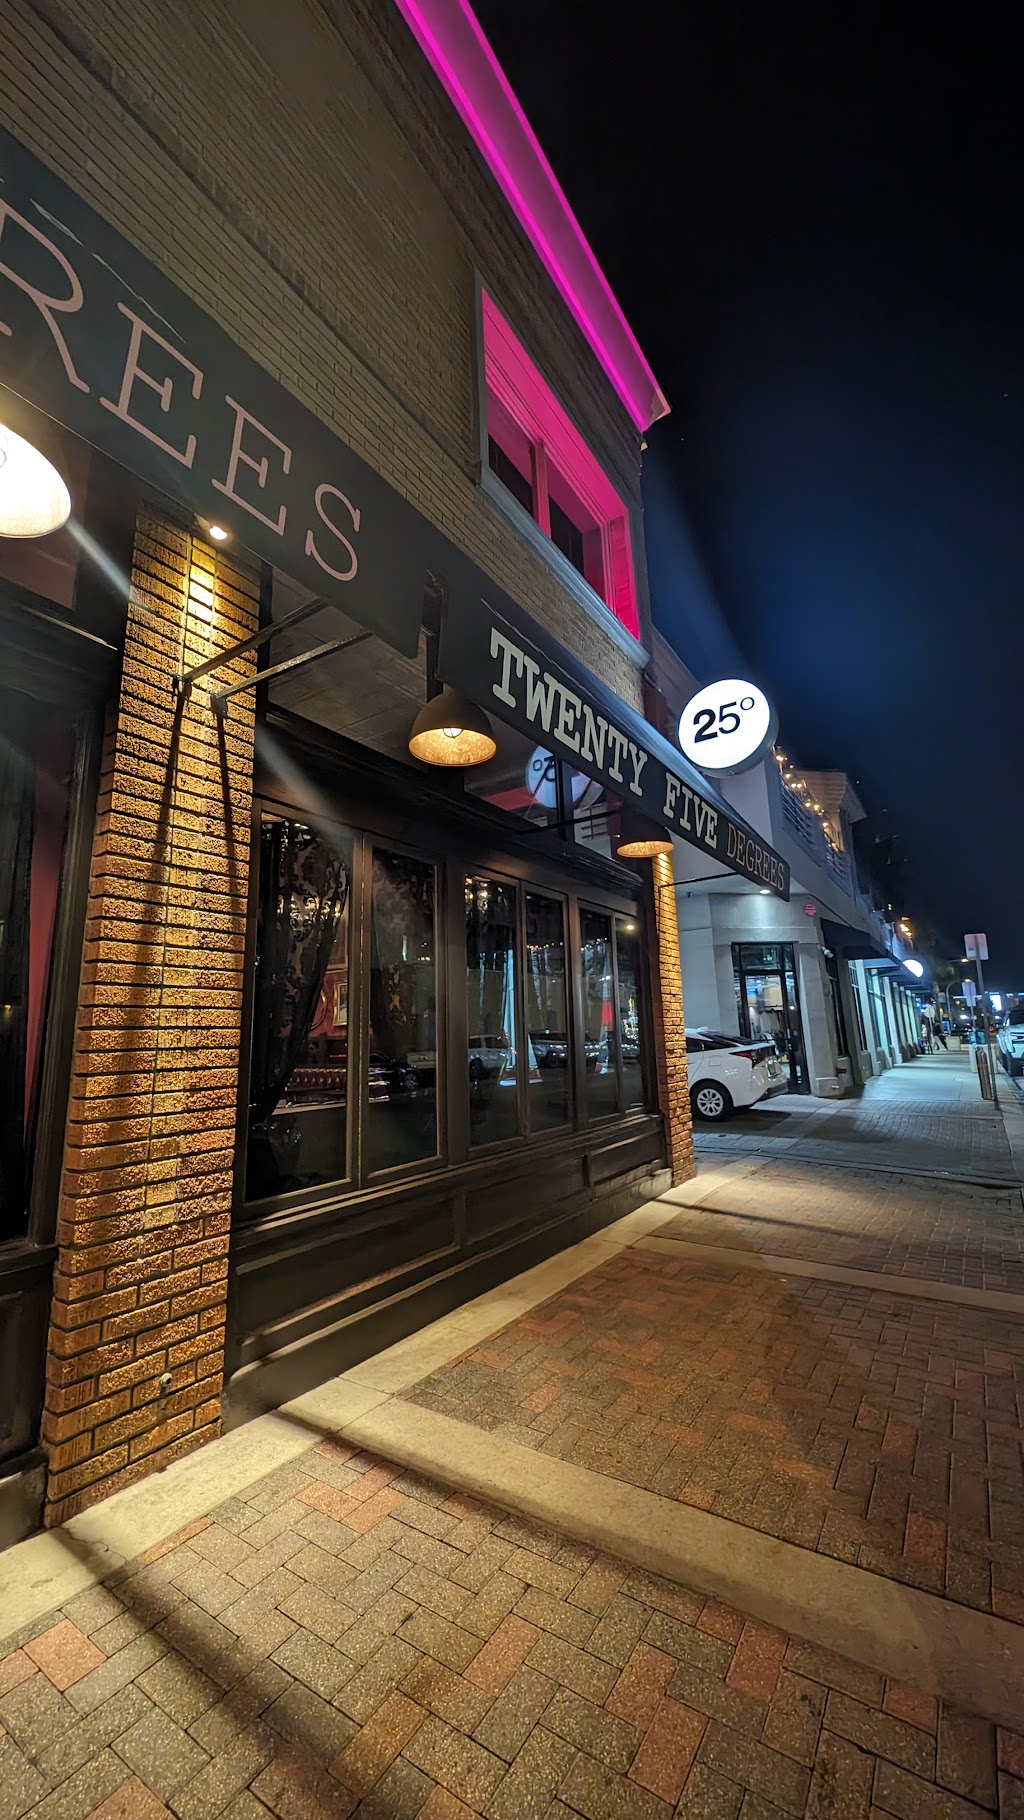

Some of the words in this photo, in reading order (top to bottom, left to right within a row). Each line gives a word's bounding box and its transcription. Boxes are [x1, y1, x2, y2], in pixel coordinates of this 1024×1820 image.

[490, 627, 648, 797] TWENTY
[663, 772, 718, 850] FIVE
[727, 823, 784, 891] DEGREES
